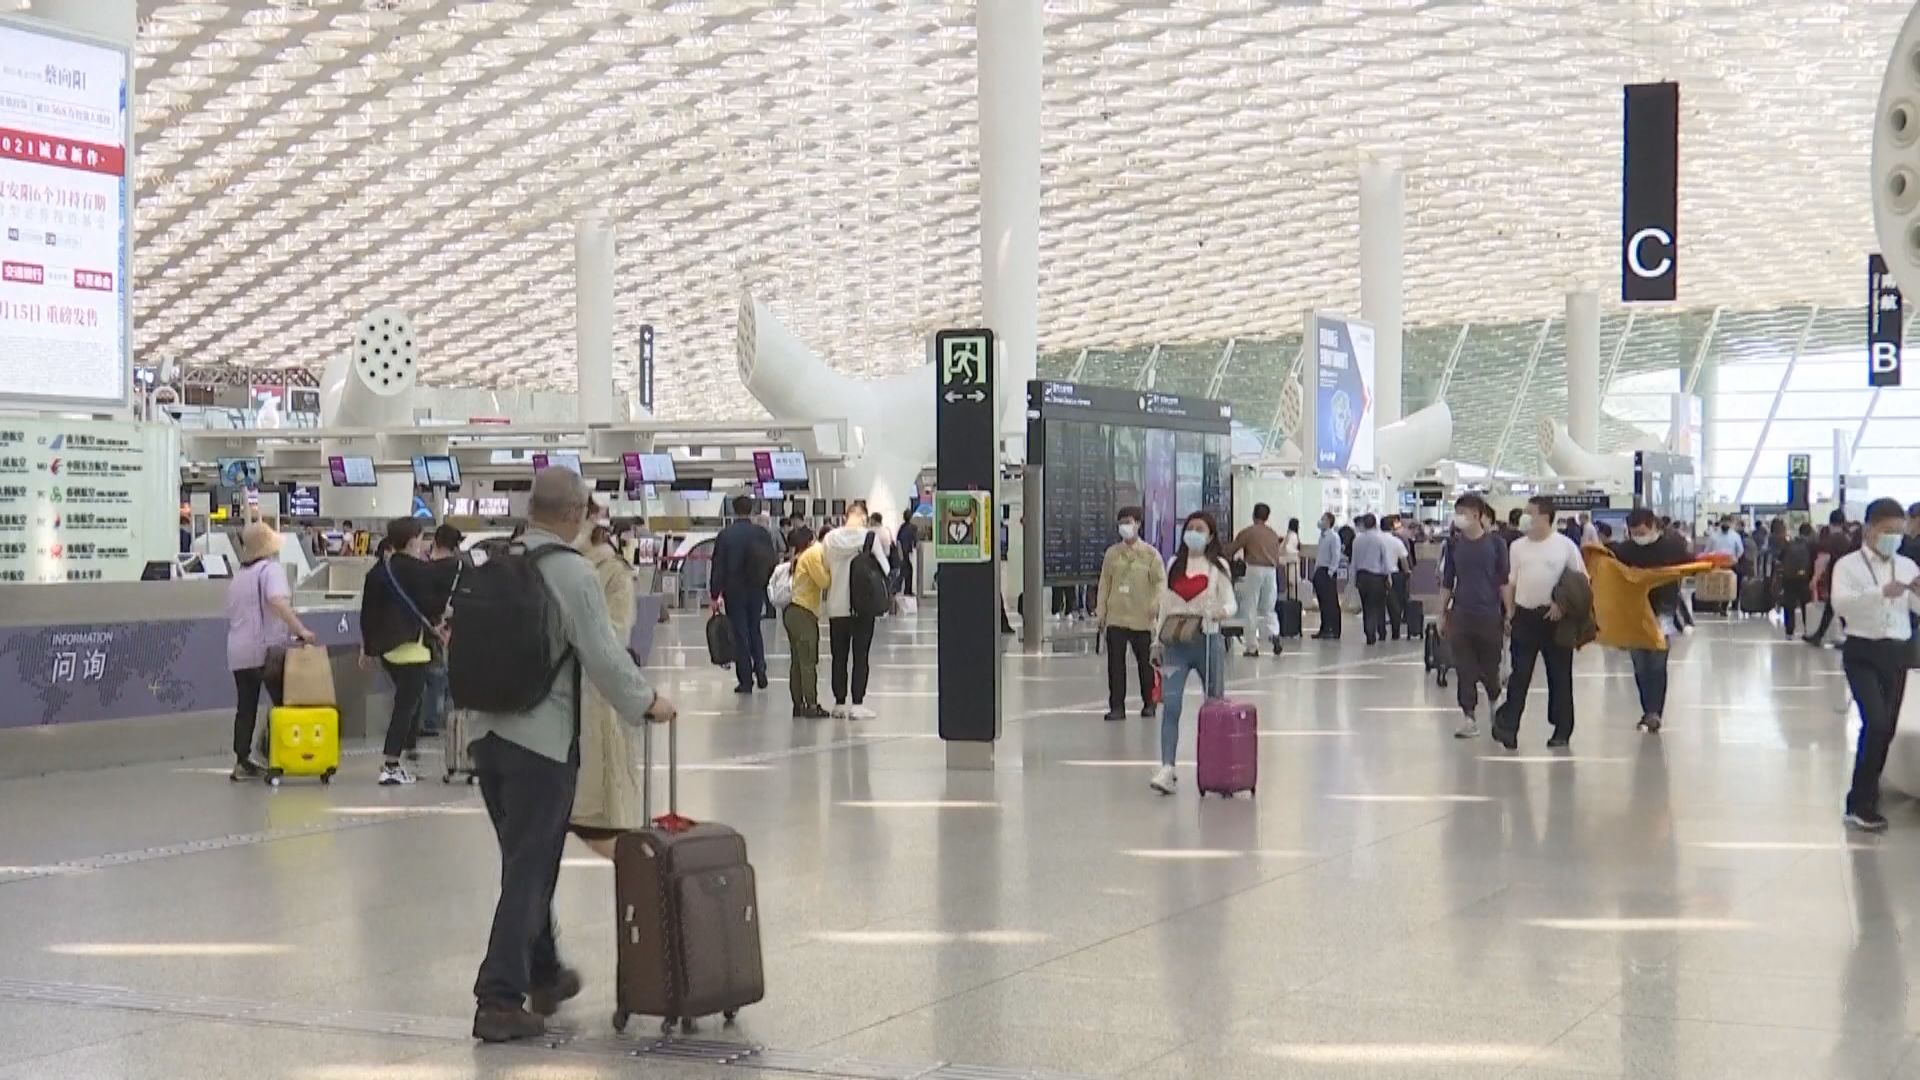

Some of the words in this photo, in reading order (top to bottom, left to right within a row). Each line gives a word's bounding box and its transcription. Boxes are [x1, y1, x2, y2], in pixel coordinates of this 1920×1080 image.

[1627, 228, 1672, 278] C
[1872, 342, 1898, 374] B
[52, 632, 114, 645] INFORMATION
[52, 648, 107, 683] 问询
